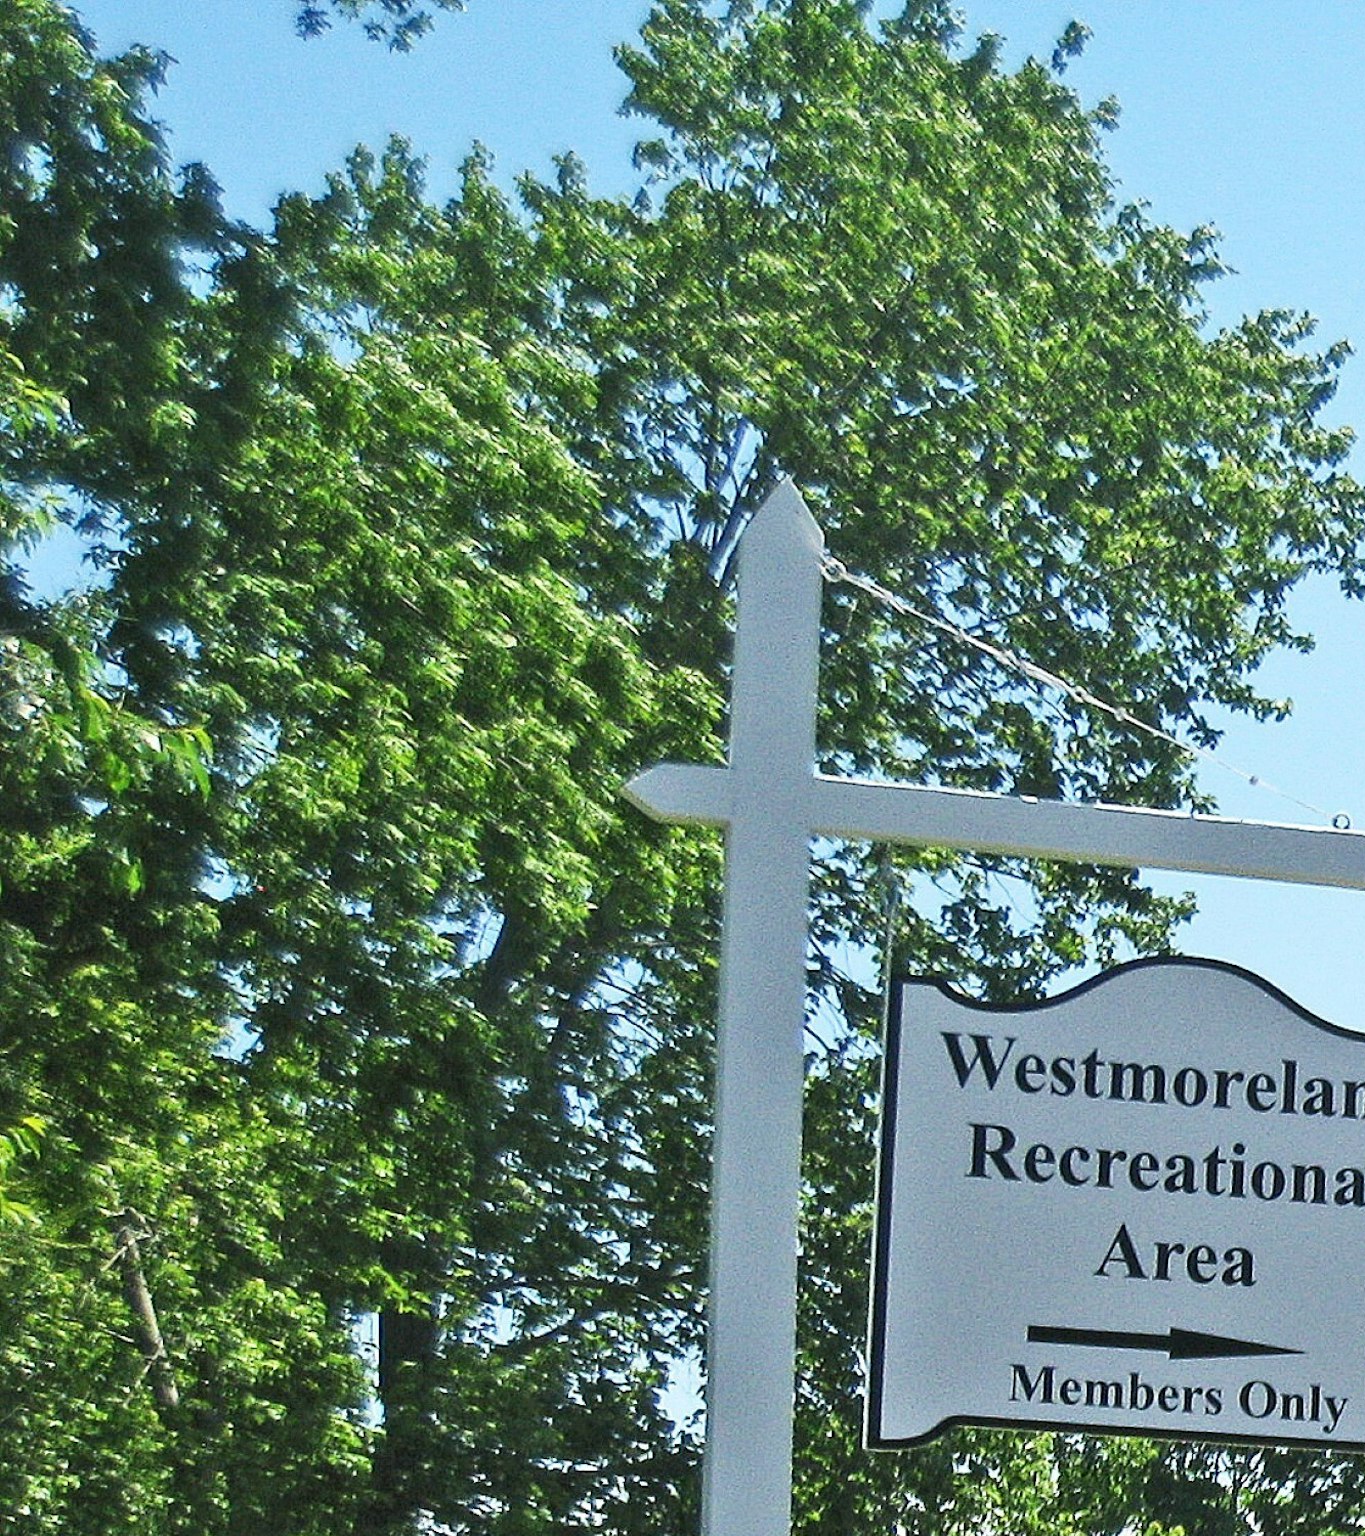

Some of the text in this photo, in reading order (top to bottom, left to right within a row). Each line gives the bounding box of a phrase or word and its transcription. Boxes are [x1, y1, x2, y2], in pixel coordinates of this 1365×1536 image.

[1093, 1222, 1258, 1288] Area
[1008, 1363, 1349, 1434] Members Only
